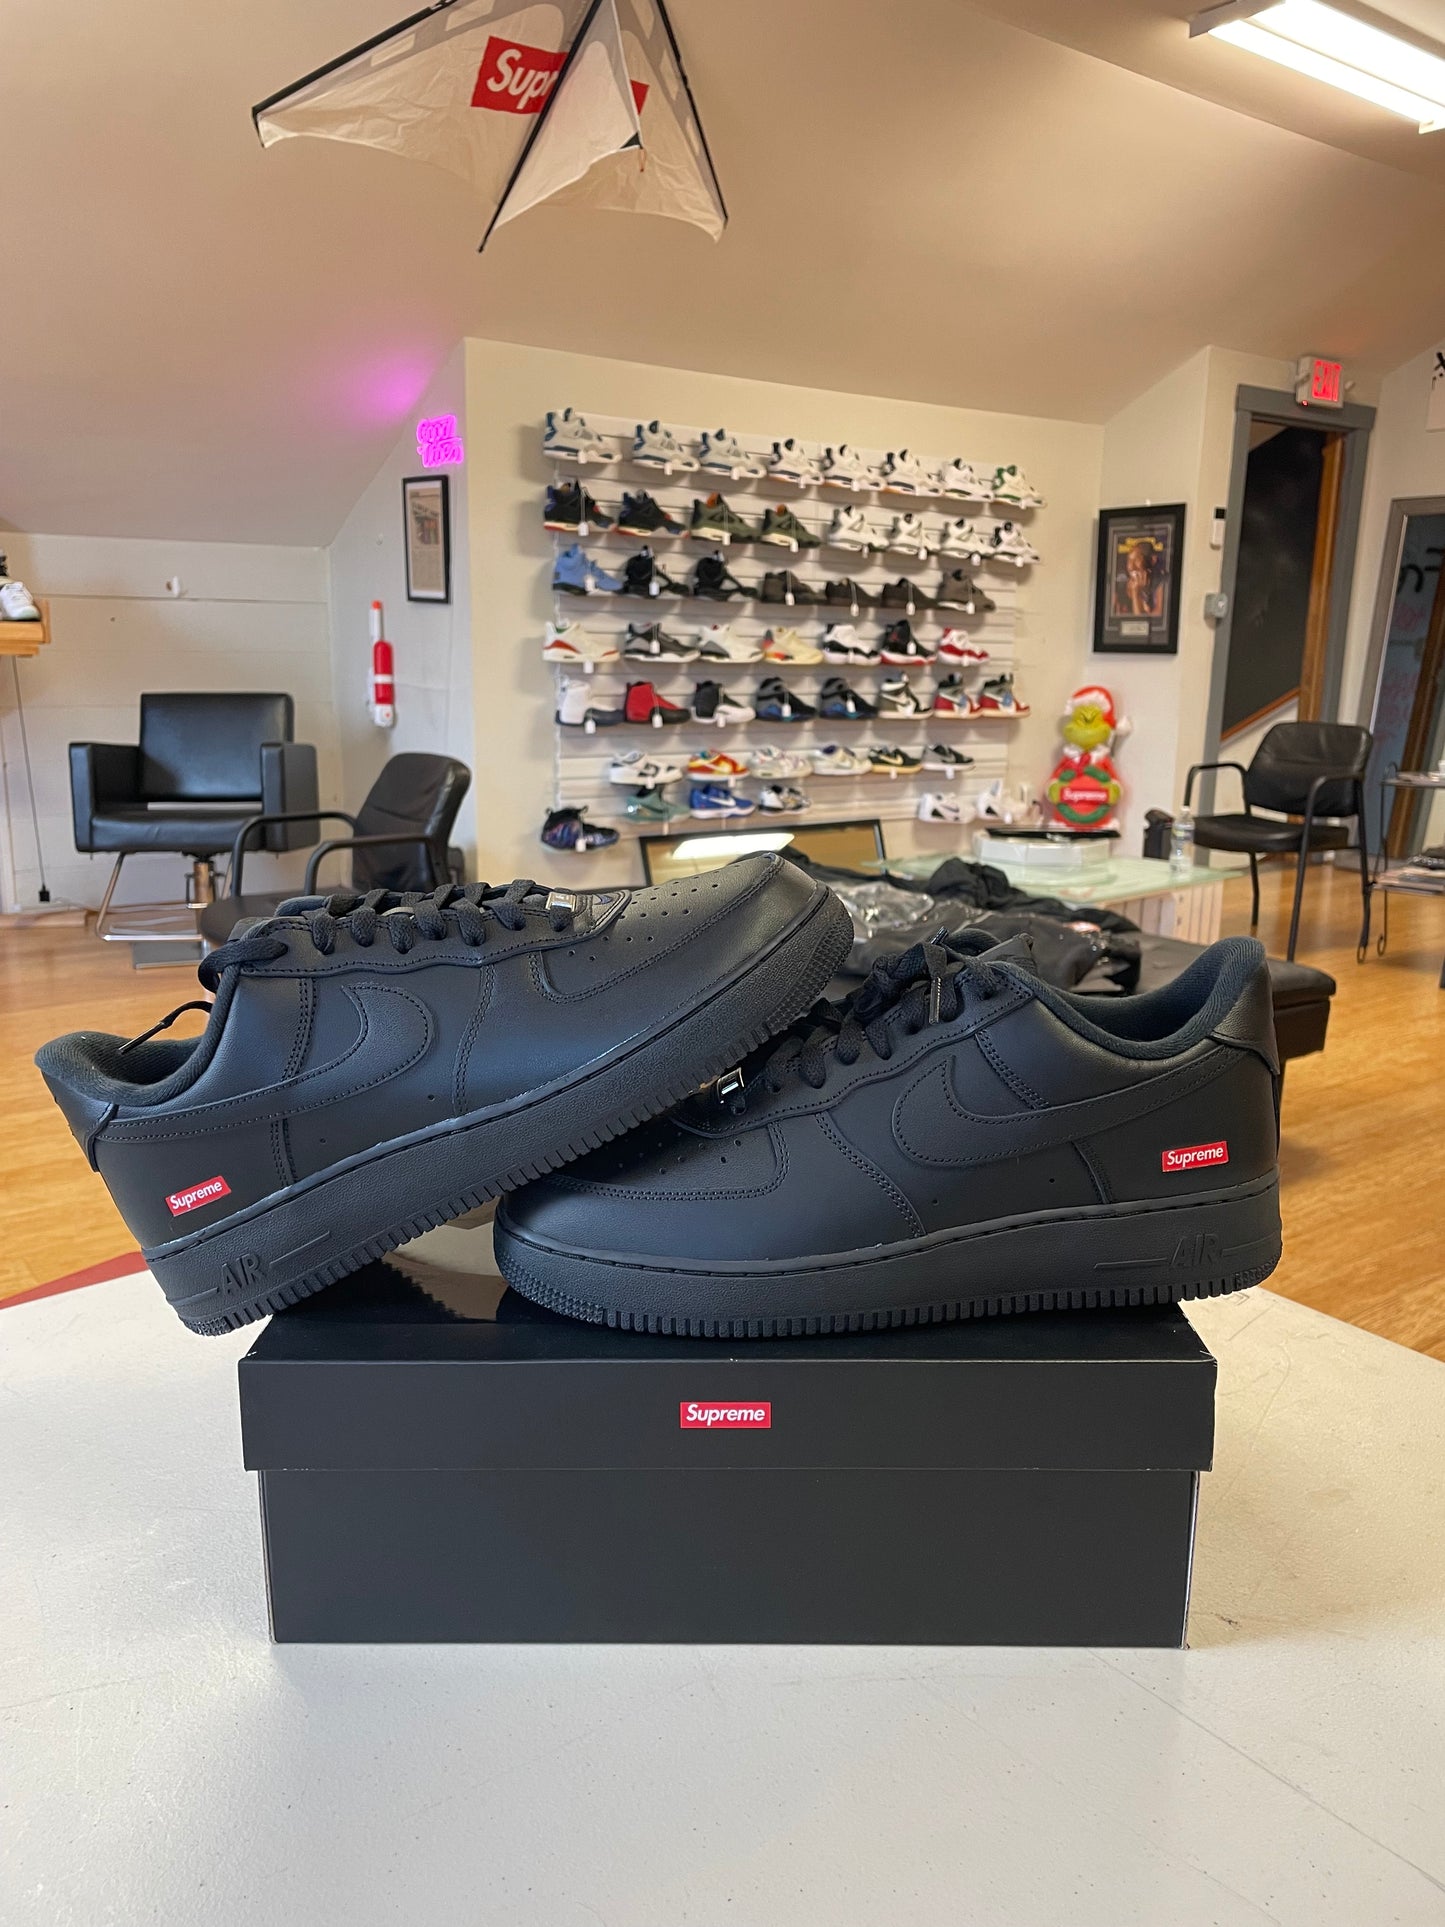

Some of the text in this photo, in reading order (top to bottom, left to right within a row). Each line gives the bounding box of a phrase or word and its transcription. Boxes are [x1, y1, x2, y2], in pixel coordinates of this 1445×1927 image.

[486, 48, 559, 110] Supr
[1312, 359, 1342, 402] EXIT
[1063, 787, 1107, 803] Supreme
[1167, 1147, 1224, 1168] Supreme
[169, 1181, 223, 1210] Supreme
[1169, 1232, 1220, 1269] AIR
[221, 1252, 267, 1297] AIR
[686, 1403, 766, 1427] Supreme
